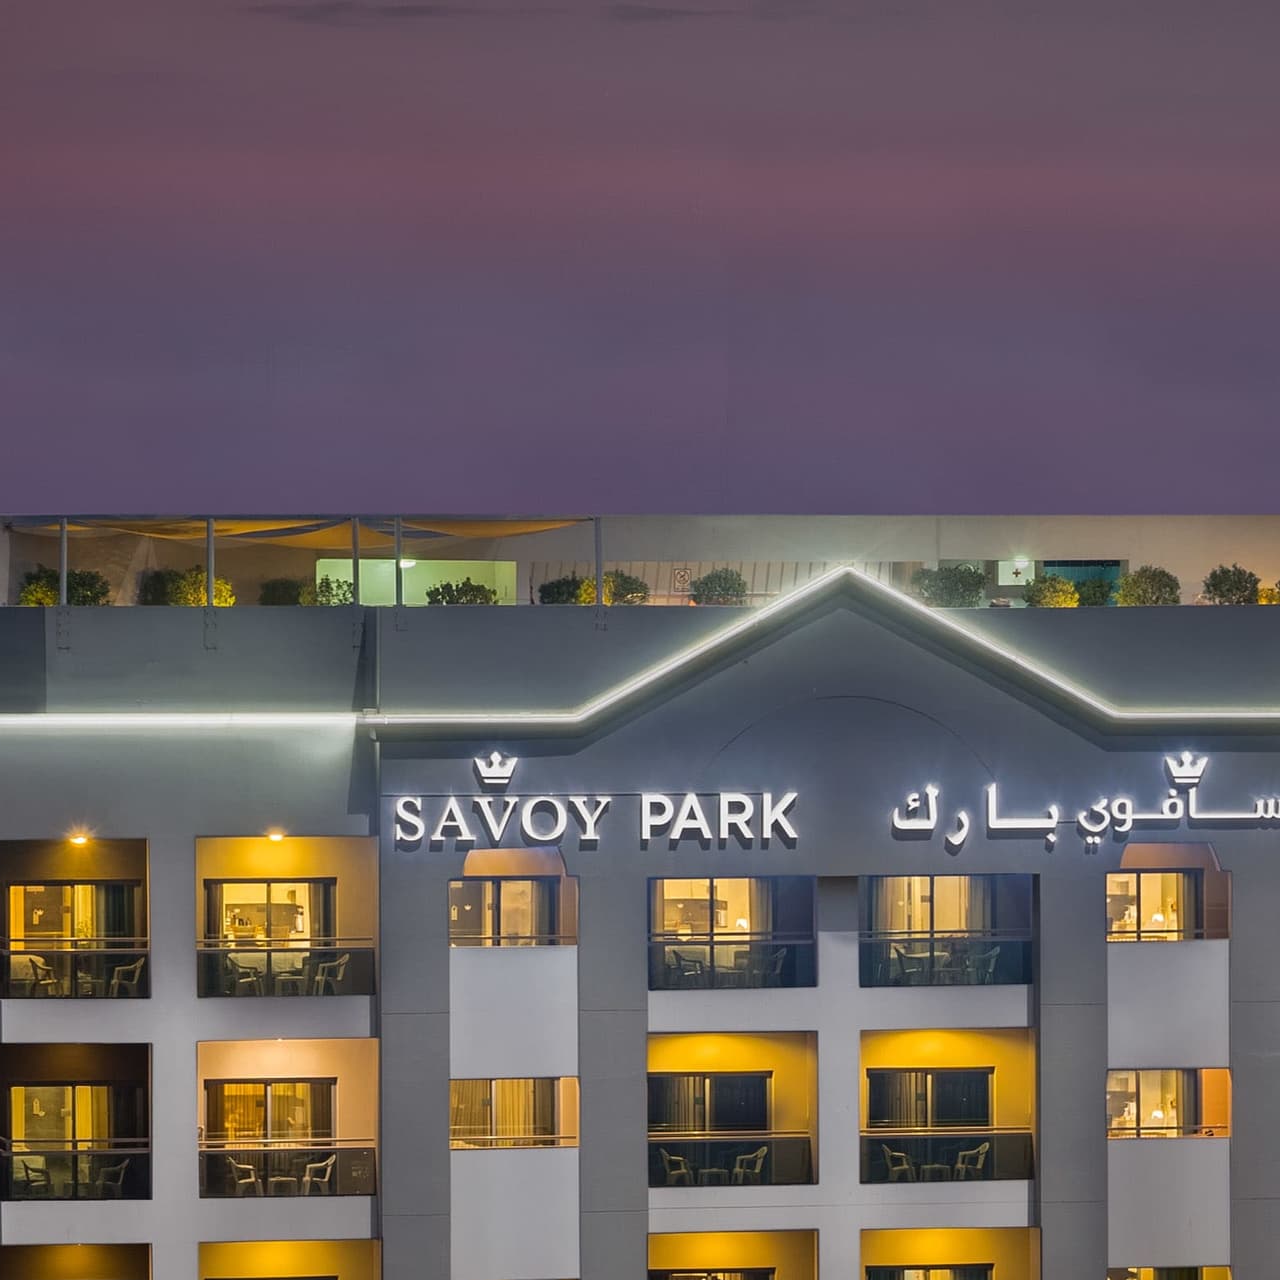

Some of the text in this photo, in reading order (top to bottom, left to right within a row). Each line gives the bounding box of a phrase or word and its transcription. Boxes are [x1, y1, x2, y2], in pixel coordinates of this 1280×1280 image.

[395, 791, 800, 841] SAVOY PARK
[892, 782, 1060, 845] بارك
